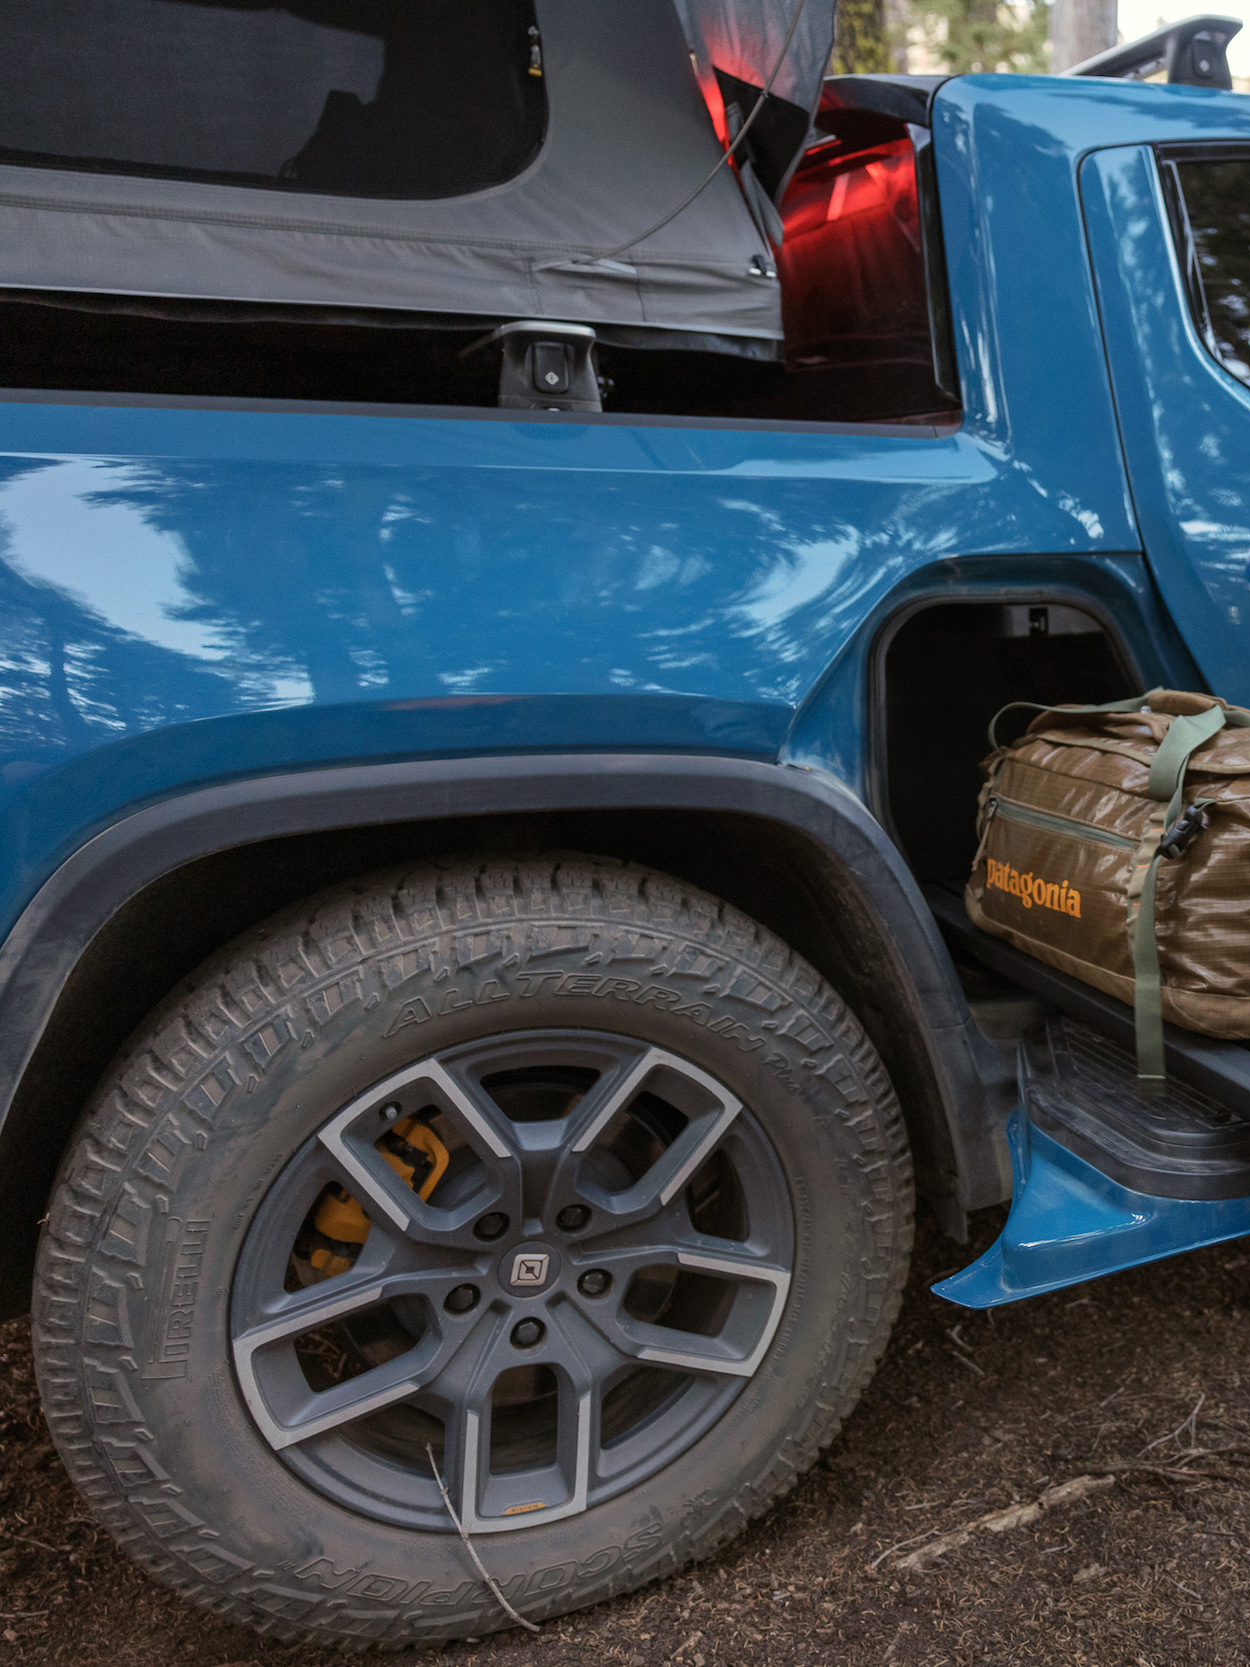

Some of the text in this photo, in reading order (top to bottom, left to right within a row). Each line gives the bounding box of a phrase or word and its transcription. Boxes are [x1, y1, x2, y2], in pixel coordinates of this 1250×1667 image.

[986, 858, 1081, 918] patagonia
[141, 1216, 211, 1380] PIRELLI
[294, 1522, 661, 1606] SCORPION
